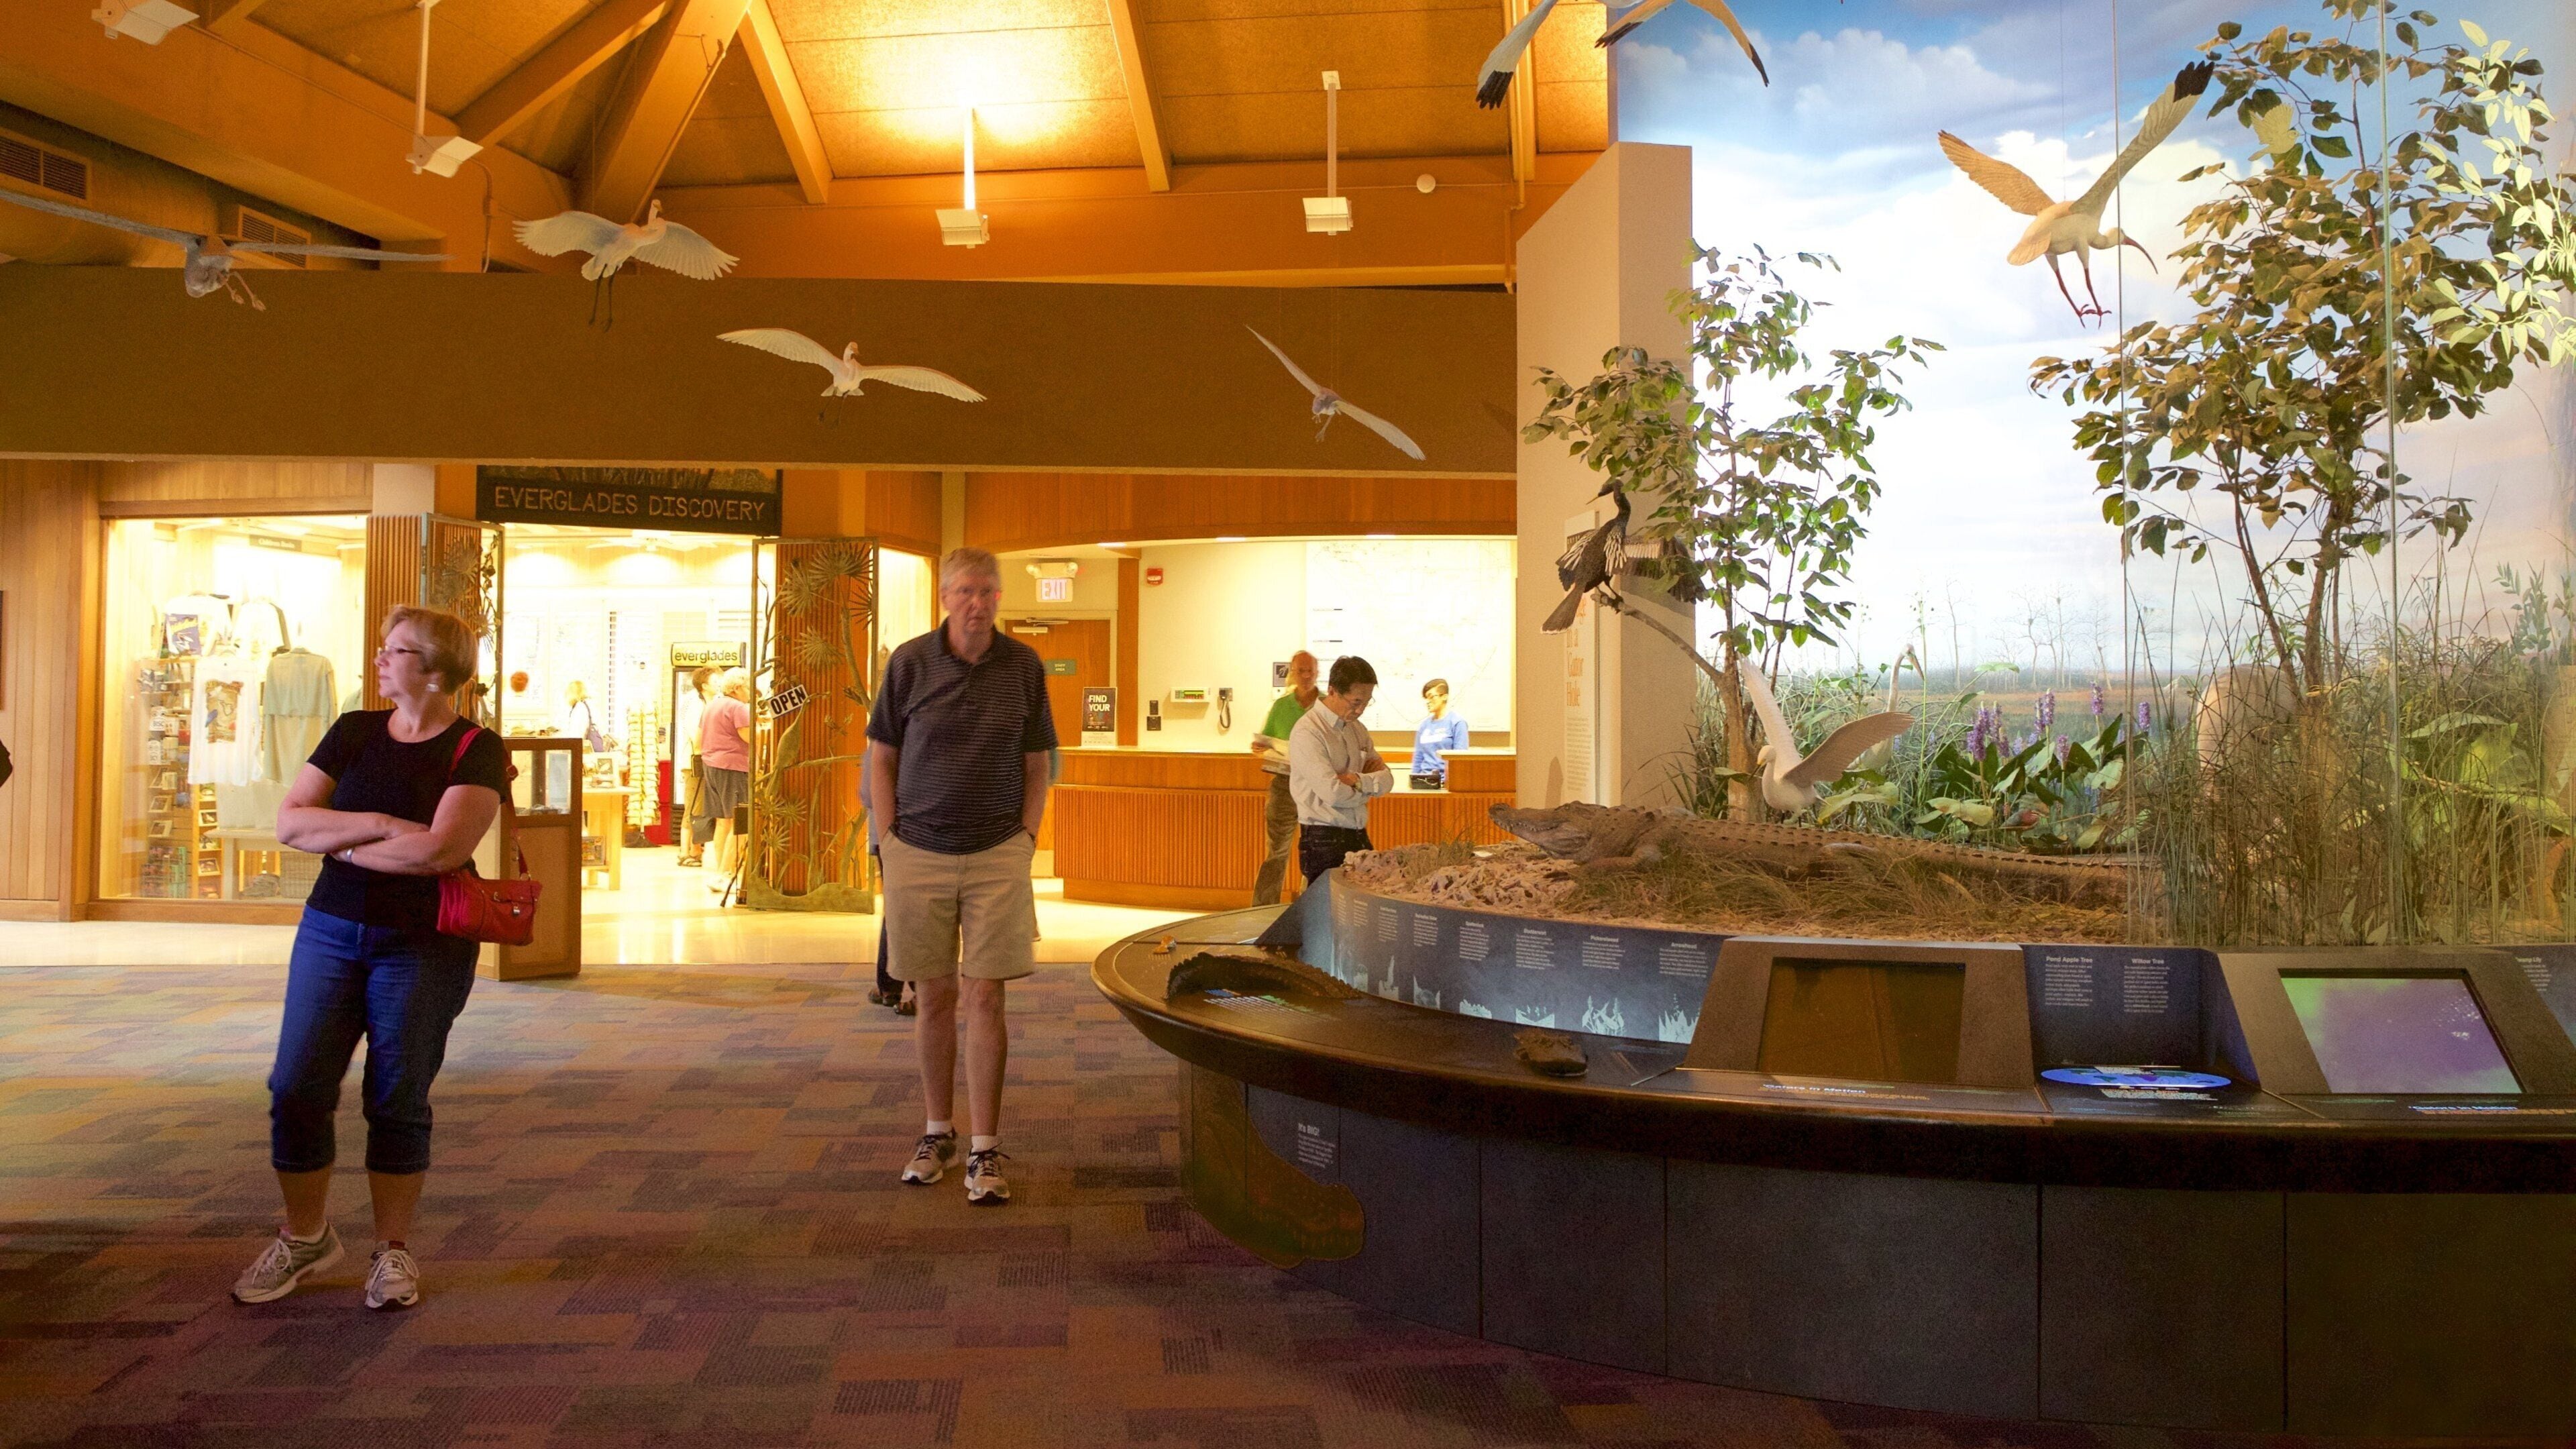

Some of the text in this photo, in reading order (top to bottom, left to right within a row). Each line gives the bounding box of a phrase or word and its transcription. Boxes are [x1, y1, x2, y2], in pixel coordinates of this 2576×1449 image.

[495, 486, 765, 521] EVERGLADES DISCOVERY
[1041, 578, 1067, 600] EXIT
[675, 650, 738, 663] everglades
[770, 686, 806, 714] OPEN
[1088, 694, 1108, 703] FIND
[1088, 703, 1111, 711] YOUR
